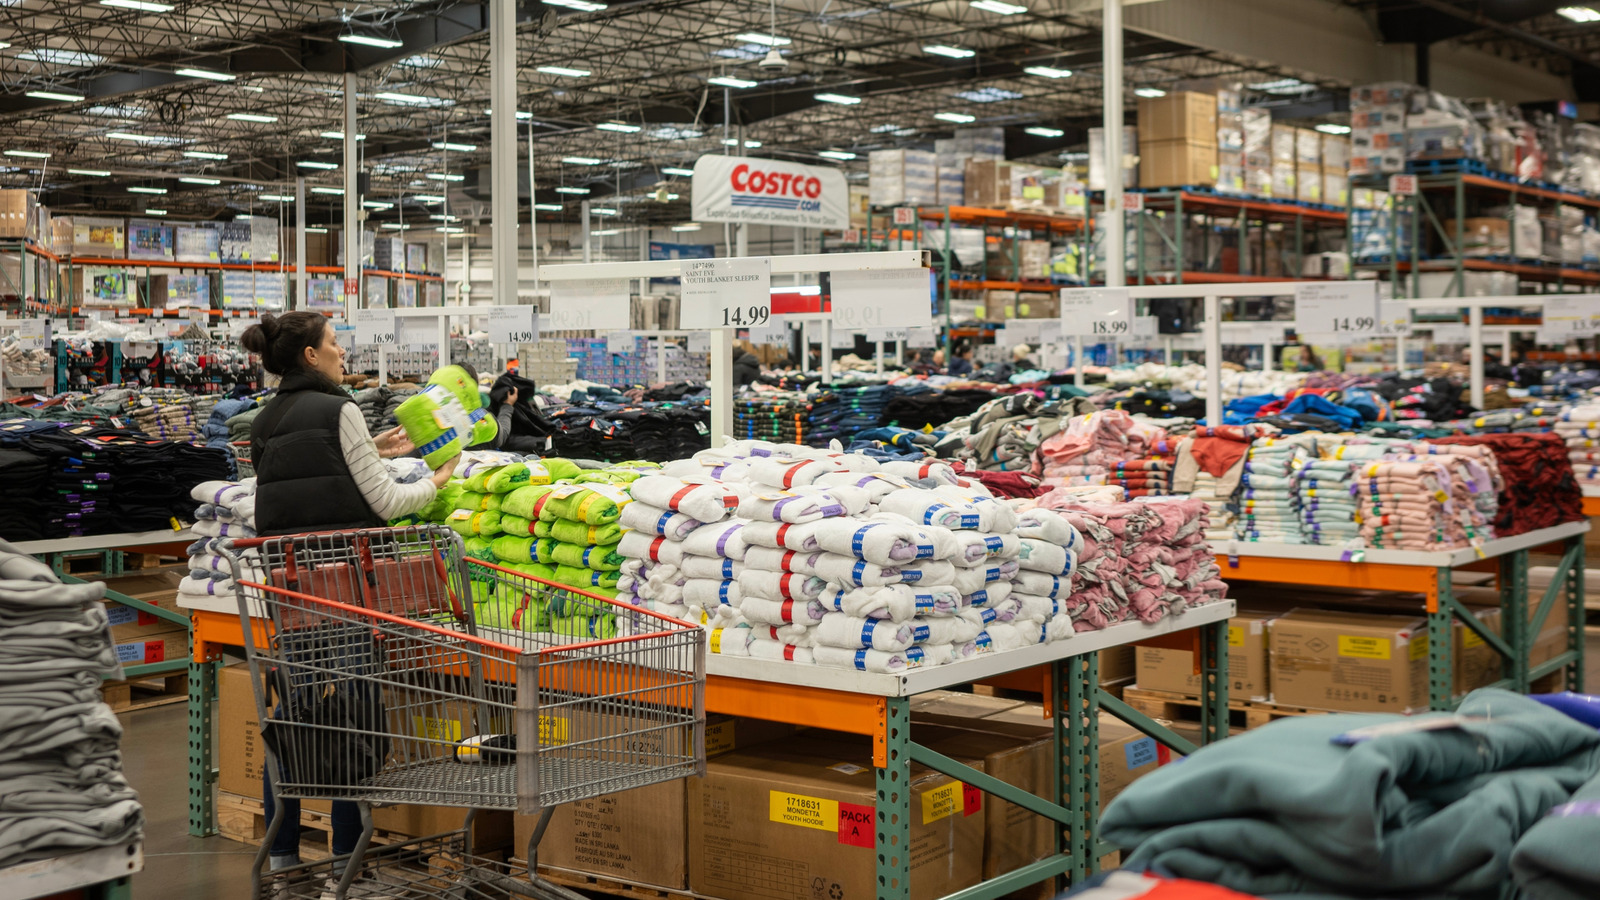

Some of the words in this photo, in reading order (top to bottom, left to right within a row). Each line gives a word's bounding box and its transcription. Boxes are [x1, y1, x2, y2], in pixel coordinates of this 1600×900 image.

[730, 163, 821, 199] COSTCO
[722, 305, 769, 326] 14.99
[1092, 321, 1128, 334] 18.99
[1333, 317, 1374, 332] 14.99
[373, 333, 394, 343] 16.99
[509, 331, 532, 342] 14.99
[786, 797, 820, 810] 1718631
[786, 806, 820, 818] MONDETTA
[841, 810, 871, 824] PACK
[782, 814, 801, 822] YOUTH
[802, 817, 824, 826] HOODIE
[852, 826, 860, 836] A
[574, 837, 588, 845] MADE
[604, 842, 619, 850] LANKA
[575, 846, 598, 856] FABRIQUE
[616, 853, 631, 862] LANKA
[575, 855, 592, 863] HECHO
[593, 857, 599, 865] EN
[600, 858, 608, 867] SRI
[609, 860, 625, 869] LANKA
